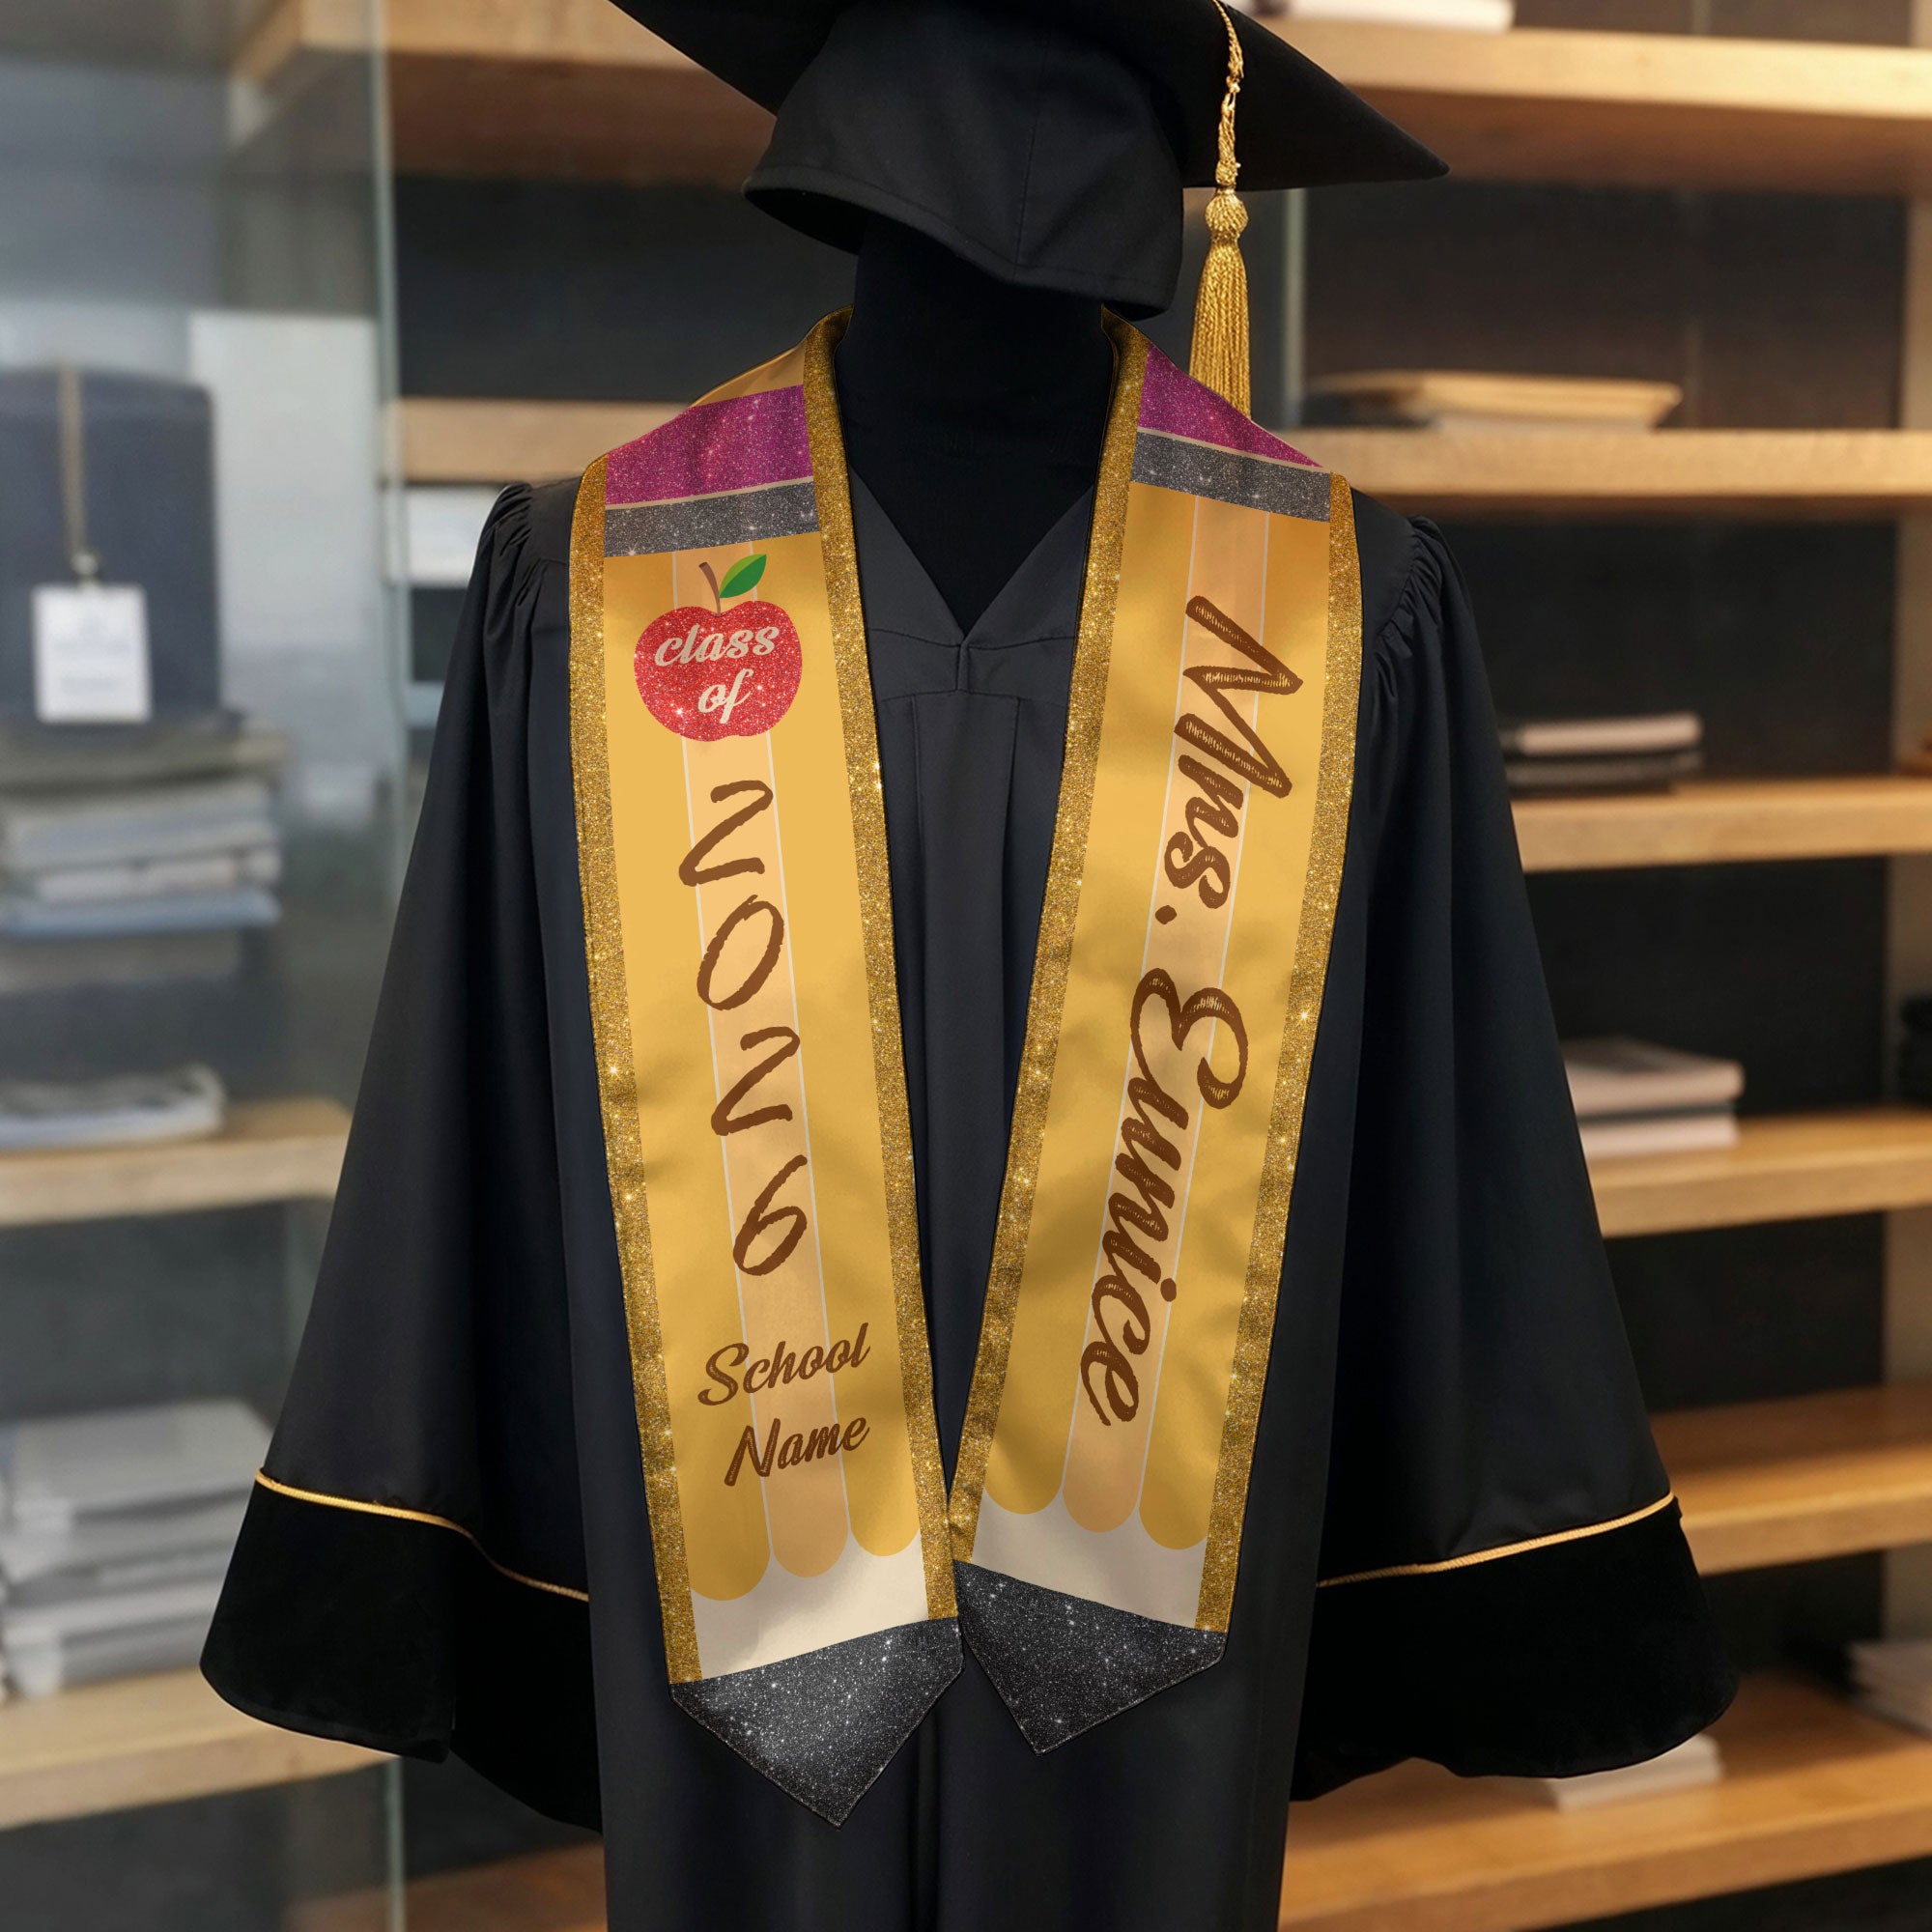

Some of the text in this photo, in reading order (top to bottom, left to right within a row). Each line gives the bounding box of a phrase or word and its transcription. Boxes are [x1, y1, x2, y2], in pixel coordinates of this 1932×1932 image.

[654, 623, 781, 668] class
[697, 668, 753, 724] of
[679, 780, 808, 1277] 2026
[1080, 595, 1304, 1427] Mrs. Eunice
[697, 1321, 870, 1406] School
[724, 1417, 869, 1488] Name
